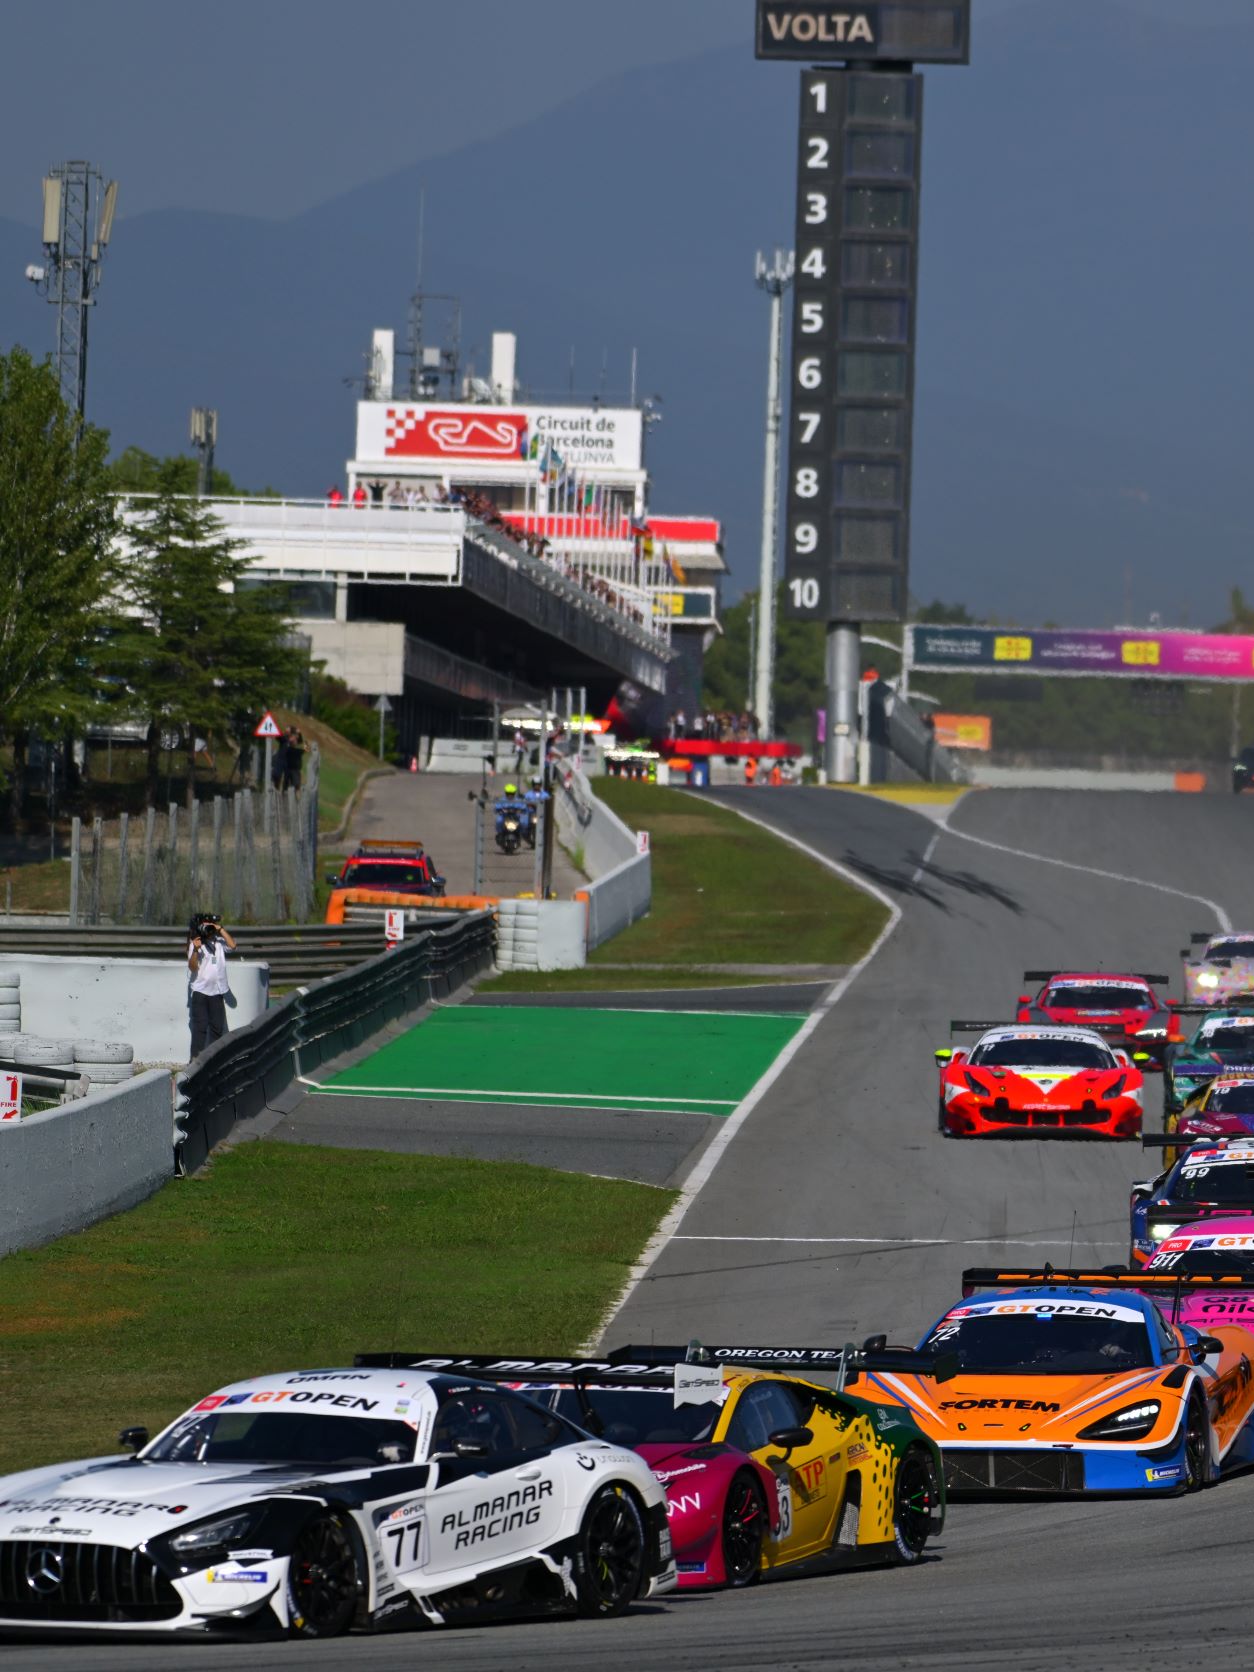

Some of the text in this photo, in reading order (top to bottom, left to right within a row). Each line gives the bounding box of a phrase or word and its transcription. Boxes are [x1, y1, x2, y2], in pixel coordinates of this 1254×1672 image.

[767, 13, 873, 42] VOLTA
[810, 83, 827, 112] 1
[807, 138, 828, 168] 2
[805, 193, 827, 223] 3
[801, 248, 826, 278] 4
[802, 303, 823, 333] 5
[799, 358, 822, 389] 6
[536, 415, 616, 432] Circuit de
[799, 413, 820, 443] 7
[795, 468, 819, 498] 8
[795, 523, 818, 553] 9
[789, 578, 819, 608] 10
[1184, 1167, 1210, 1179] 99
[1149, 1252, 1185, 1269] 911
[951, 1308, 967, 1317] PRO
[996, 1304, 1118, 1318] GTOPEN
[928, 1326, 961, 1344] 72
[714, 1348, 809, 1359] OREGON
[250, 1390, 380, 1412] GTOPEN
[937, 1399, 1062, 1413] FORTEM
[1158, 1467, 1181, 1478] MICHELIN
[6, 1504, 142, 1518] RACING
[441, 1479, 553, 1534] ALMANAR
[455, 1505, 541, 1551] RACING
[387, 1520, 422, 1568] 77
